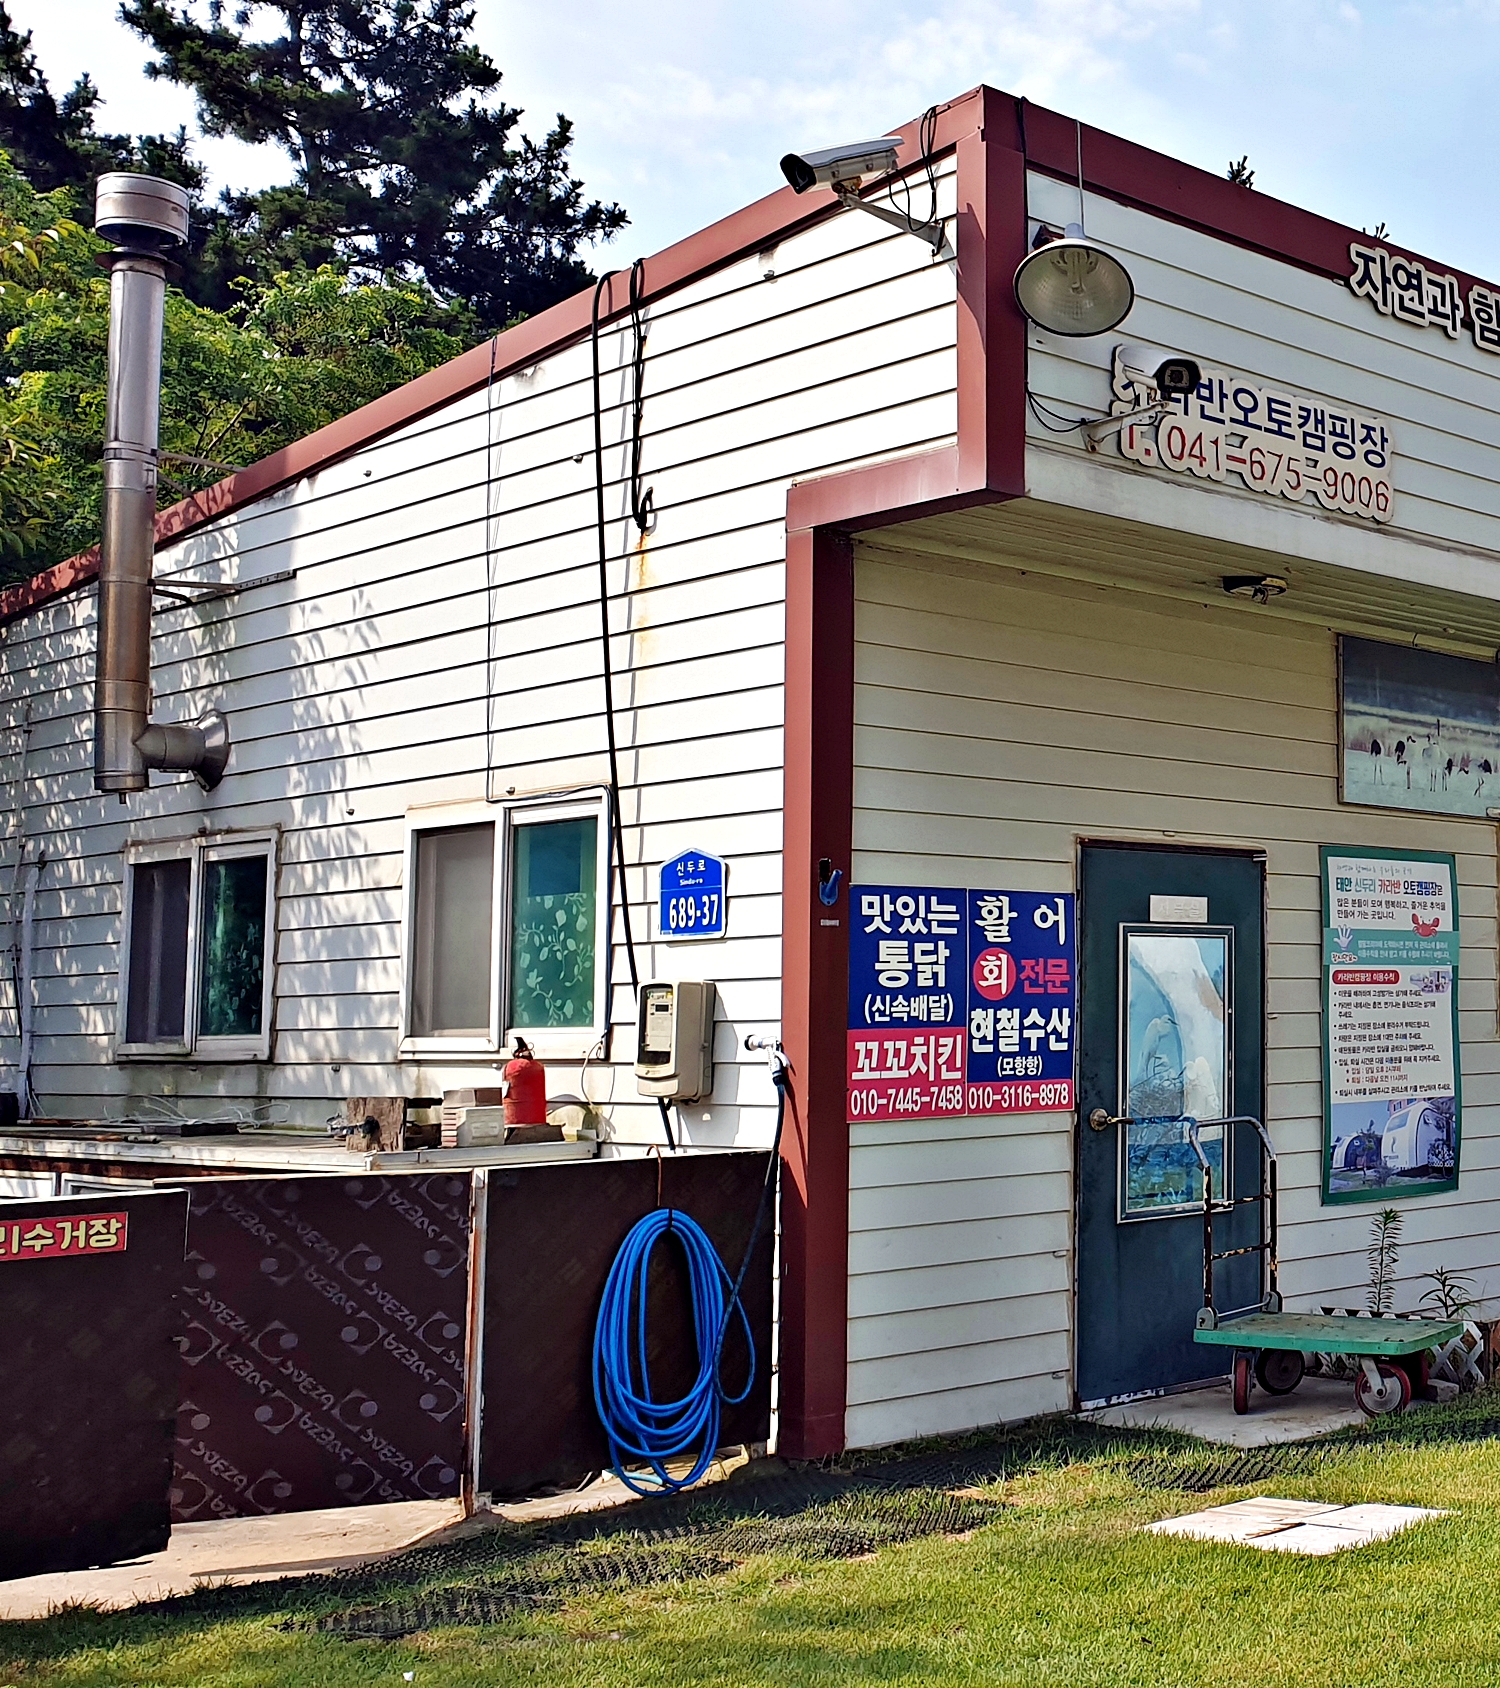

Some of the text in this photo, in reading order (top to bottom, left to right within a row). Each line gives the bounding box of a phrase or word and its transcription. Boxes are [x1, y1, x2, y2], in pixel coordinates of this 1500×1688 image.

[1355, 249, 1460, 337] 자연과
[1120, 378, 1388, 468] 반오토캠핑장
[1167, 425, 1390, 513] 041-675-9006
[676, 860, 706, 876] 신두로
[1336, 877, 1443, 896] 태안 신두리 카라반 오토캠핑장은
[669, 893, 719, 929] 689-37
[861, 894, 960, 935] 맛있는
[974, 895, 1067, 945] 활어
[1357, 910, 1369, 919] 가는
[1370, 899, 1383, 909] 모여
[874, 940, 950, 988] 통닭
[979, 953, 1071, 995] 회 전문
[864, 993, 954, 1024] (신속배달)
[970, 1007, 1071, 1054] 현철수산
[851, 1034, 963, 1082] 꼬꼬치킨
[997, 1056, 1043, 1077] (모항항)
[851, 1084, 963, 1116] 010-7445-7458
[968, 1083, 1069, 1110] 010-3116-8978
